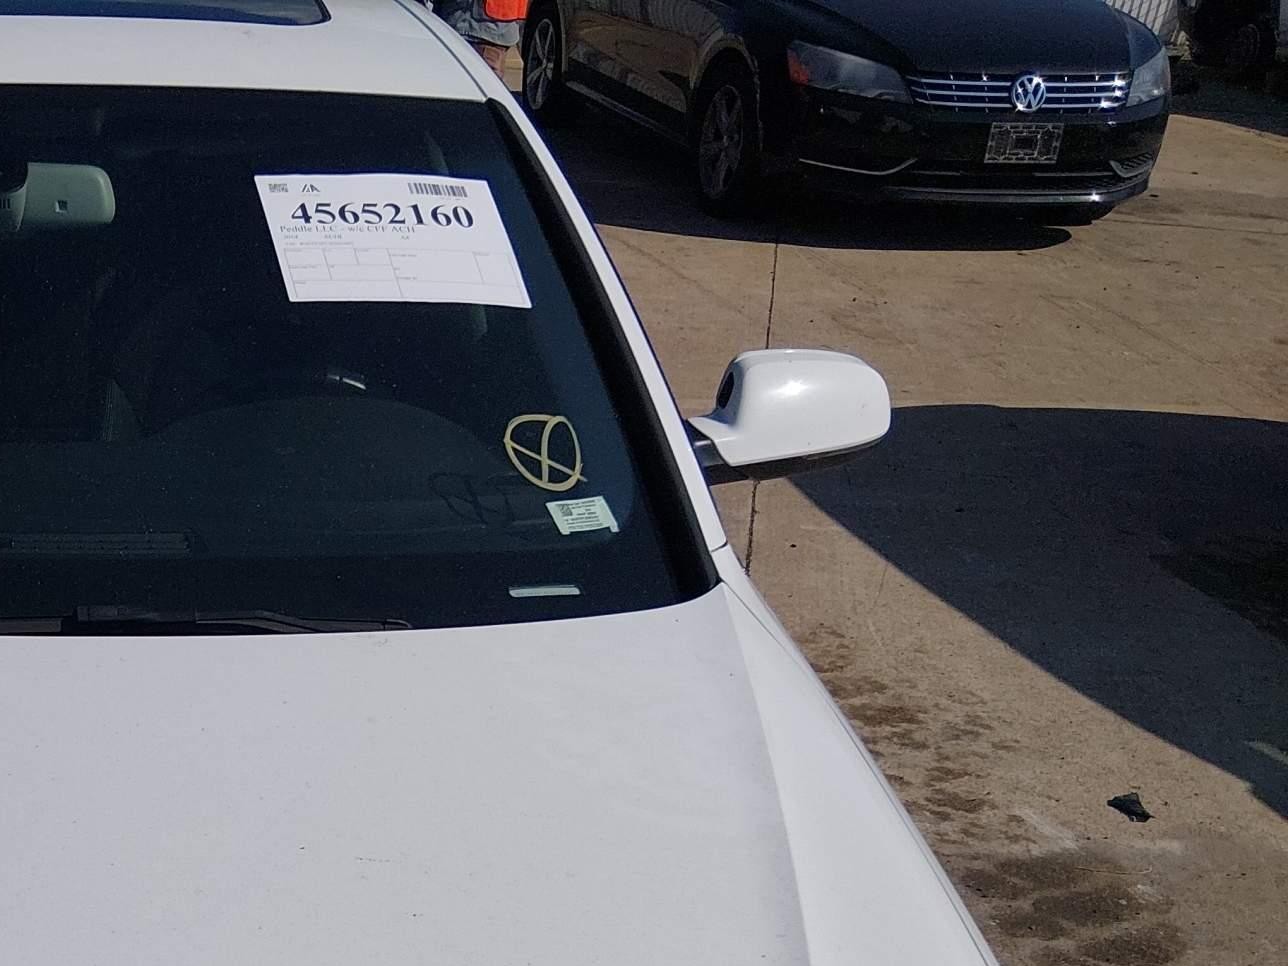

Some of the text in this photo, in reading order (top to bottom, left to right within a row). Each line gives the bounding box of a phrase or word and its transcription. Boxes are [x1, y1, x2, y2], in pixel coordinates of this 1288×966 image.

[290, 202, 474, 228] 45652160
[280, 225, 312, 233] Peddle
[315, 225, 336, 233] LLC
[391, 225, 416, 233] ACH
